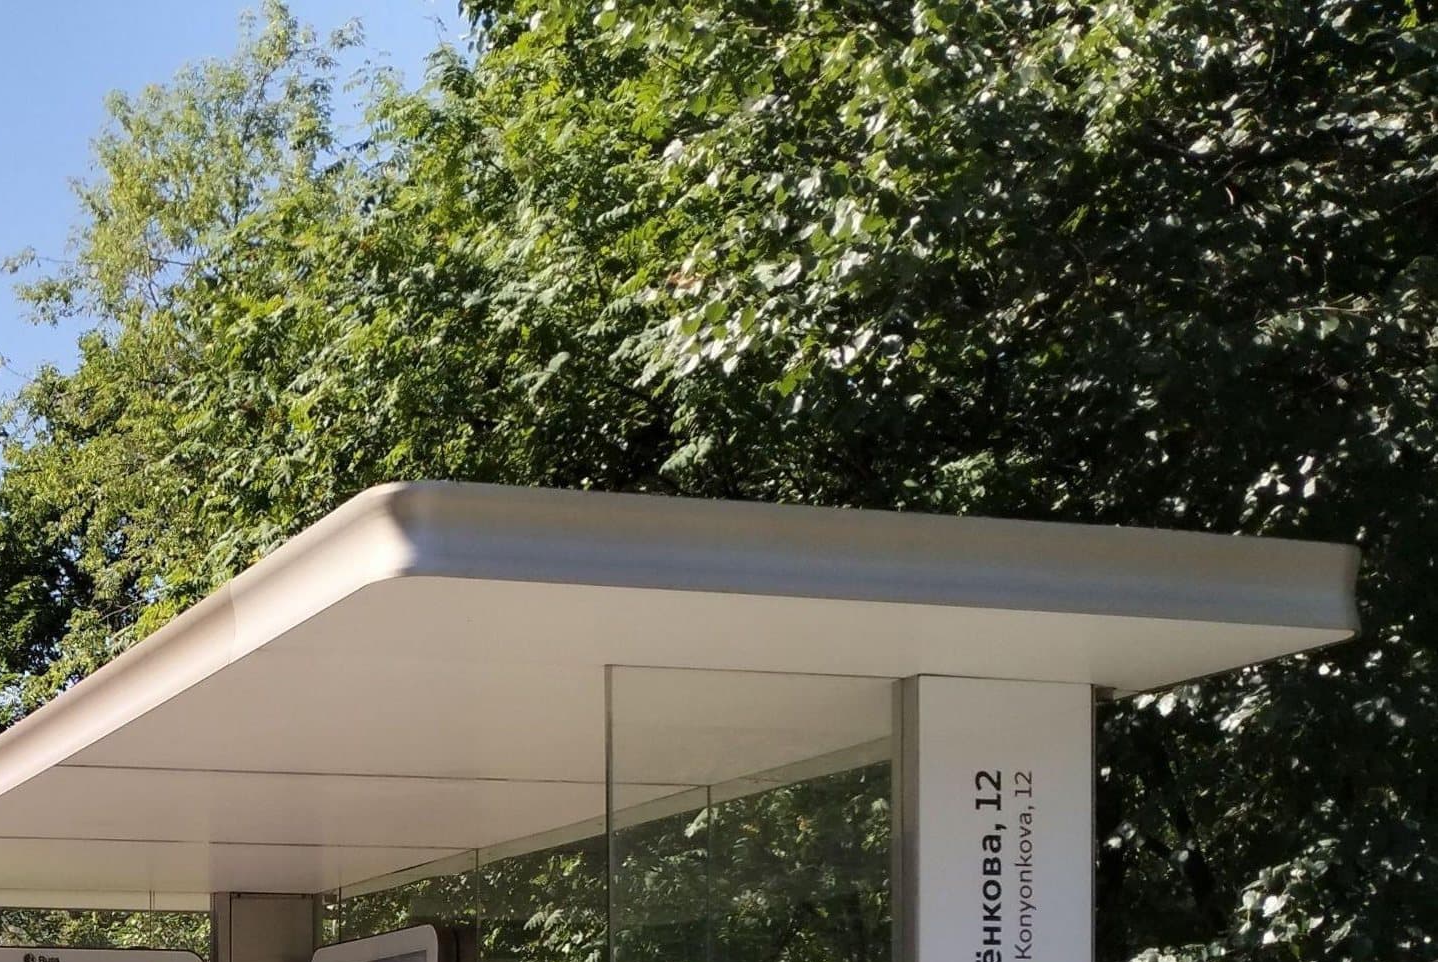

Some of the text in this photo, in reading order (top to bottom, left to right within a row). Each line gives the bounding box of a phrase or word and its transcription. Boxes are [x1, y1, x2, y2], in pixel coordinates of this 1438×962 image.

[975, 769, 1002, 812] 12
[1014, 770, 1033, 799] 12
[1014, 805, 1037, 960] Konyonkova,
